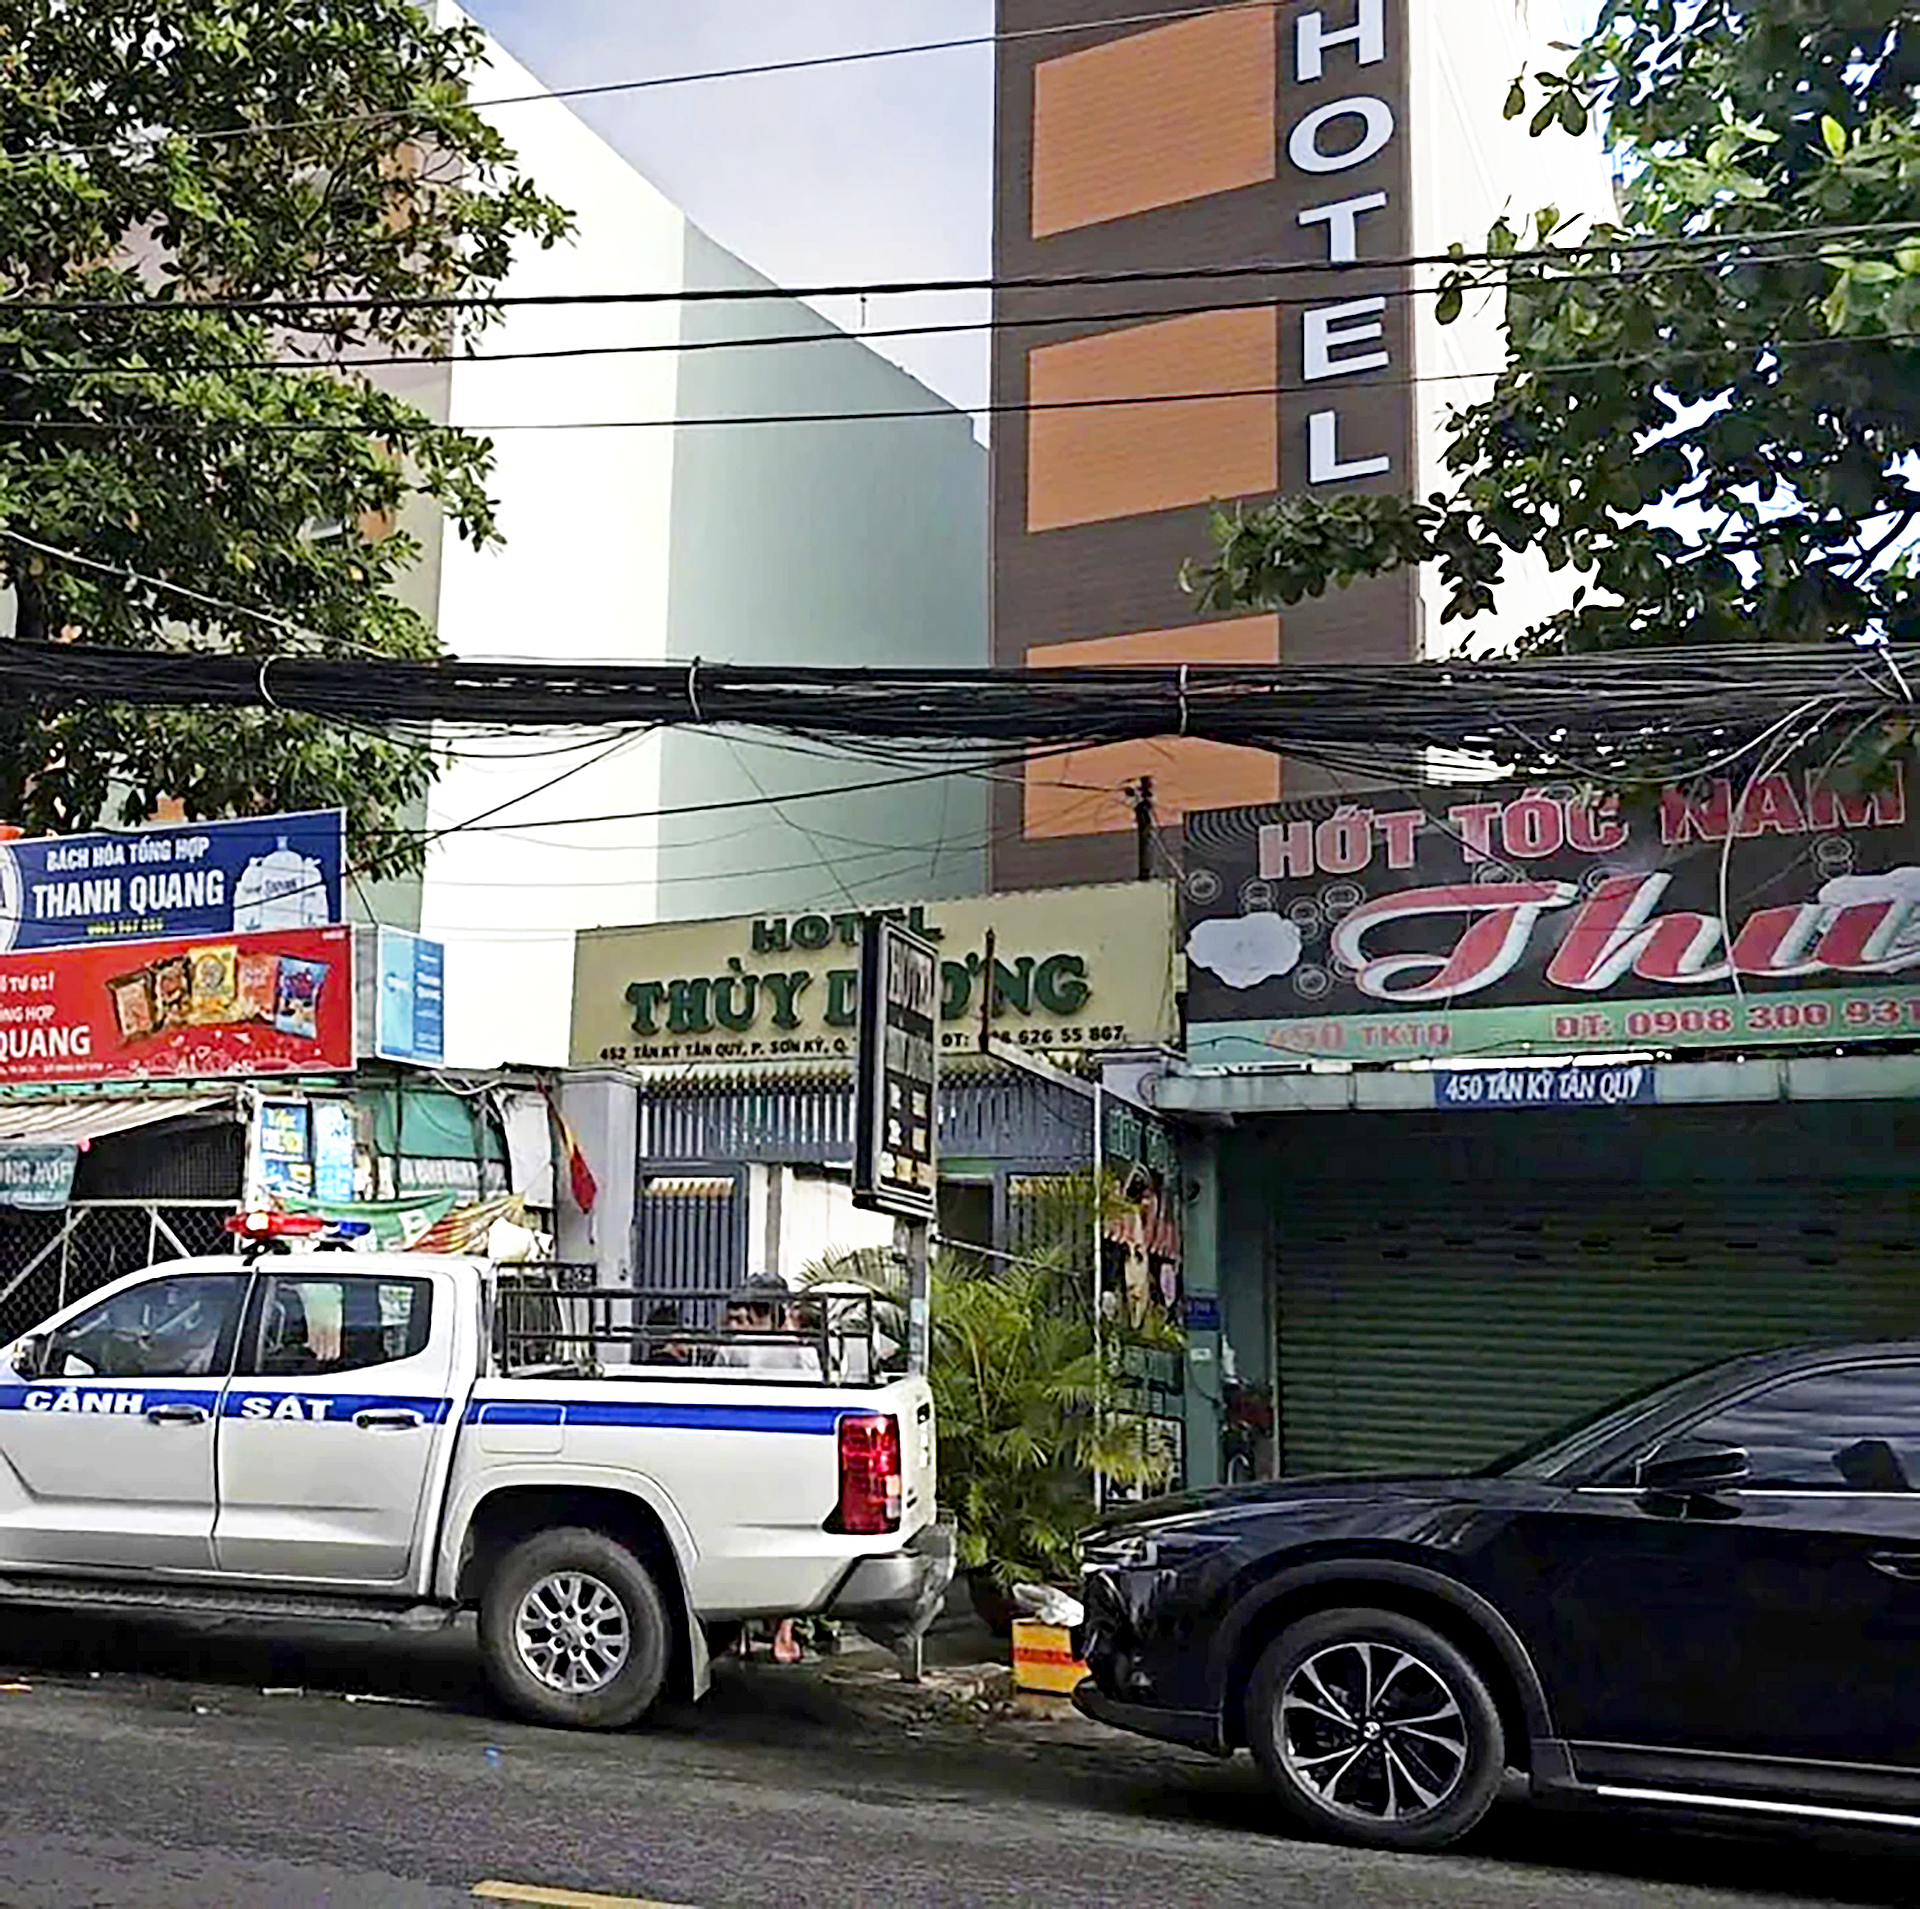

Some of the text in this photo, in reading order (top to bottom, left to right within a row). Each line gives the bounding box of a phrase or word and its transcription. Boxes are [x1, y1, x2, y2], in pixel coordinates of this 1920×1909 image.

[1287, 0, 1395, 485] HOTEL
[1258, 804, 1426, 880] HỚT
[32, 869, 225, 919] THANH QUANG
[1018, 1028, 1054, 1045] 626
[1061, 1027, 1083, 1043] 55
[1626, 1007, 1733, 1038] 0908
[1446, 1074, 1483, 1101] 450
[23, 1385, 144, 1414] CẢNH
